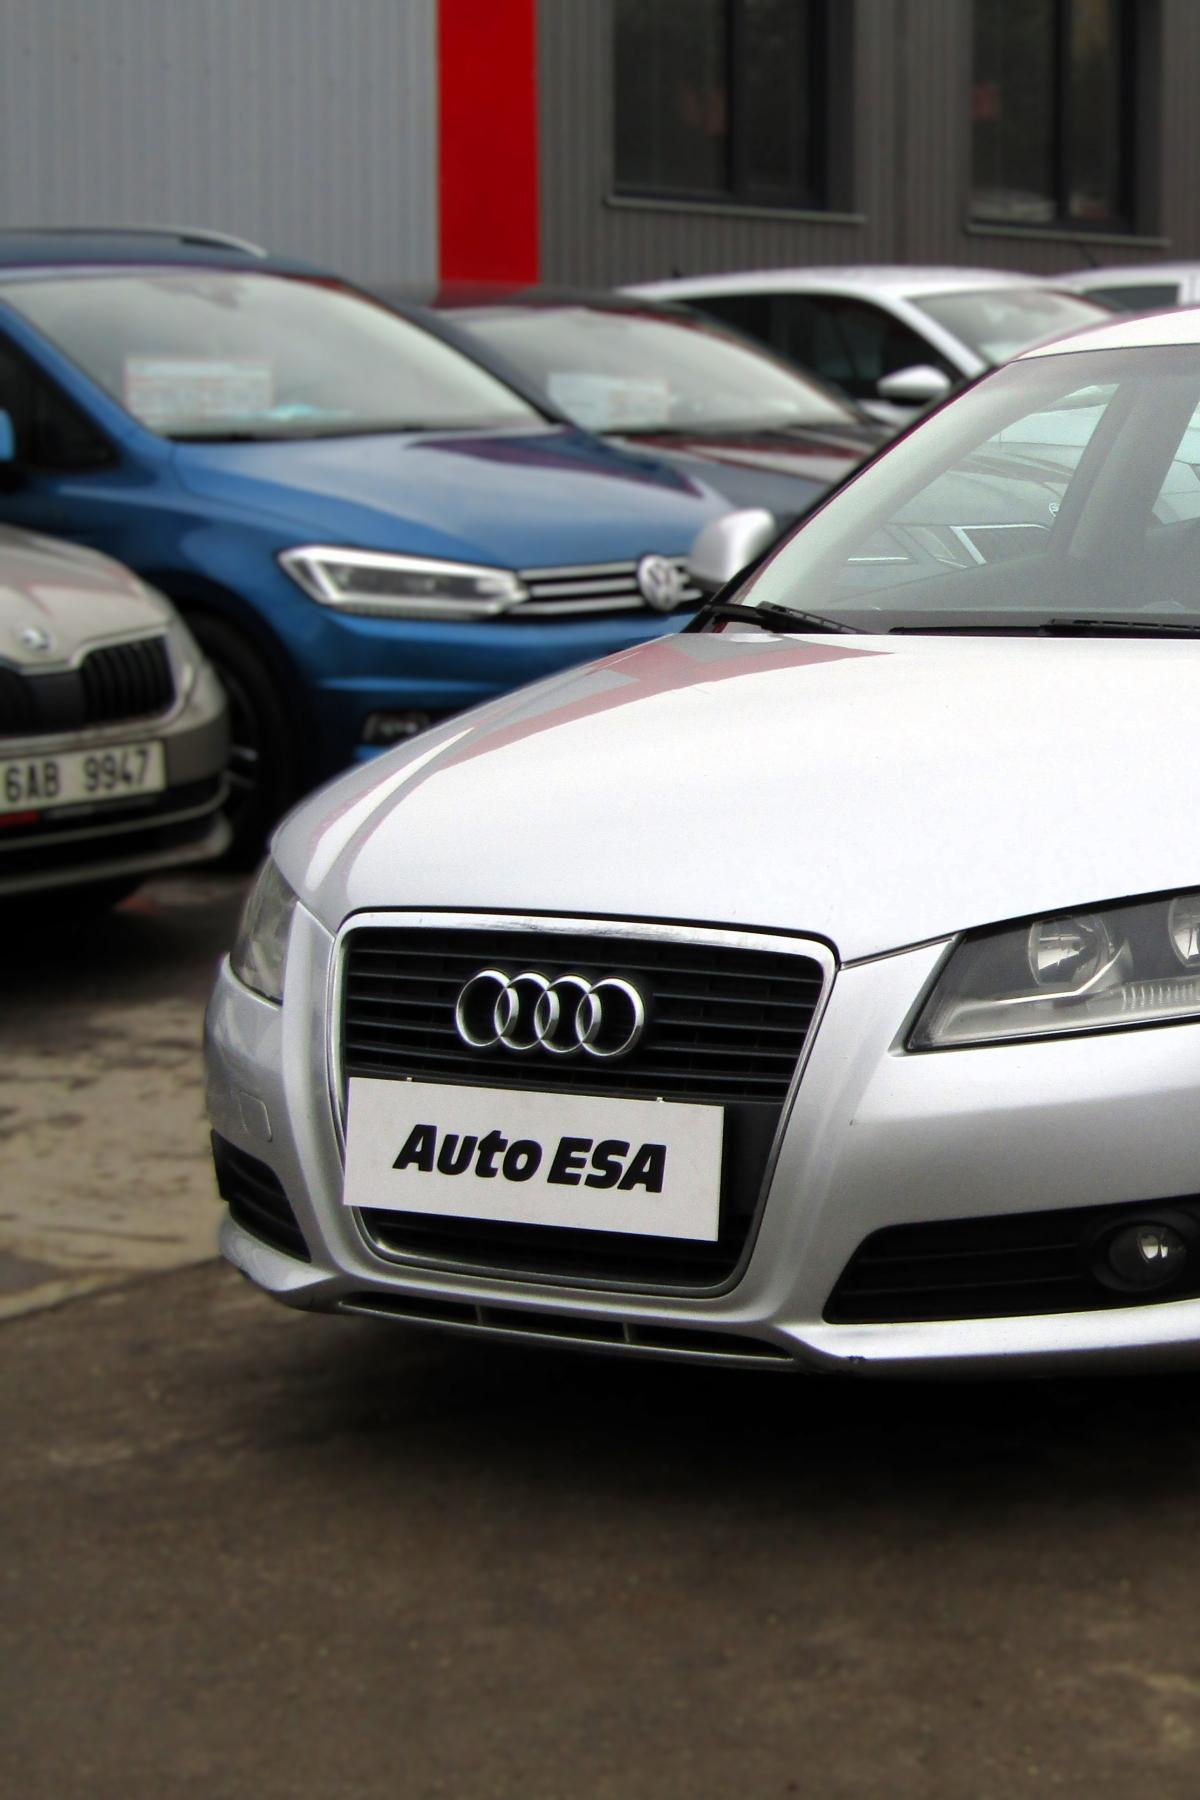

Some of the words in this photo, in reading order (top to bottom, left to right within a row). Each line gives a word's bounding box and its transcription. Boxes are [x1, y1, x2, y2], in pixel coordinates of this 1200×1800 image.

[5, 761, 60, 803] 6AB
[84, 748, 149, 793] 9947
[392, 1124, 543, 1182] Auto
[547, 1136, 667, 1193] ESA
